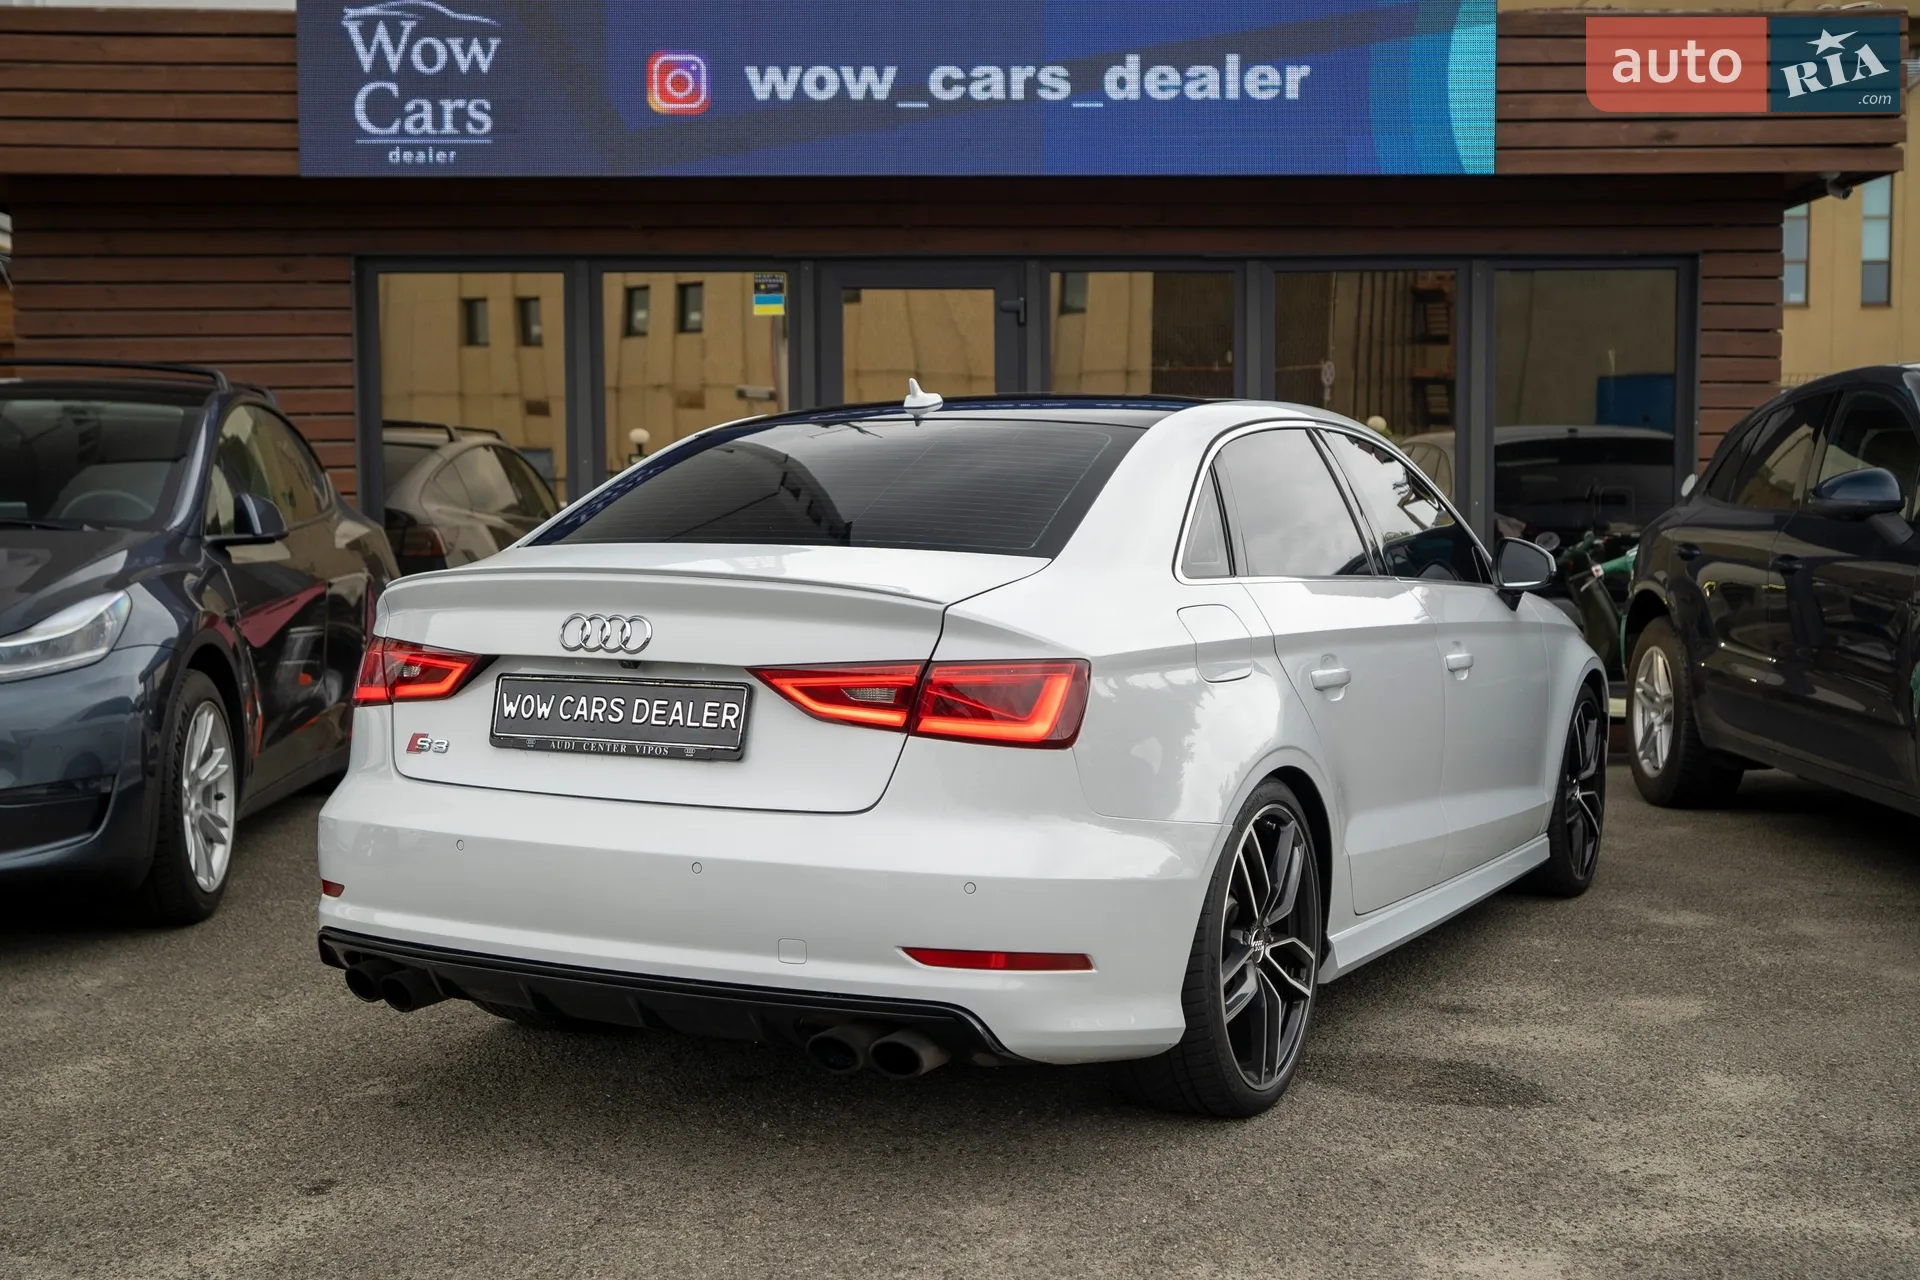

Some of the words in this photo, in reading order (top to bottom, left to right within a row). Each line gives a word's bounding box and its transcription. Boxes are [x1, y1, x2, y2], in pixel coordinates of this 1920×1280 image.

[342, 20, 501, 74] Wow
[744, 53, 1311, 107] wow_cars_dealer
[354, 82, 493, 135] Cars
[388, 147, 457, 164] dealer
[502, 692, 555, 720] WOW
[559, 695, 625, 723] CARS
[632, 700, 740, 730] DEALER
[415, 737, 450, 754] S3
[549, 740, 576, 750] AUDI
[583, 741, 627, 754] CENTER
[635, 745, 669, 756] VIPOS
